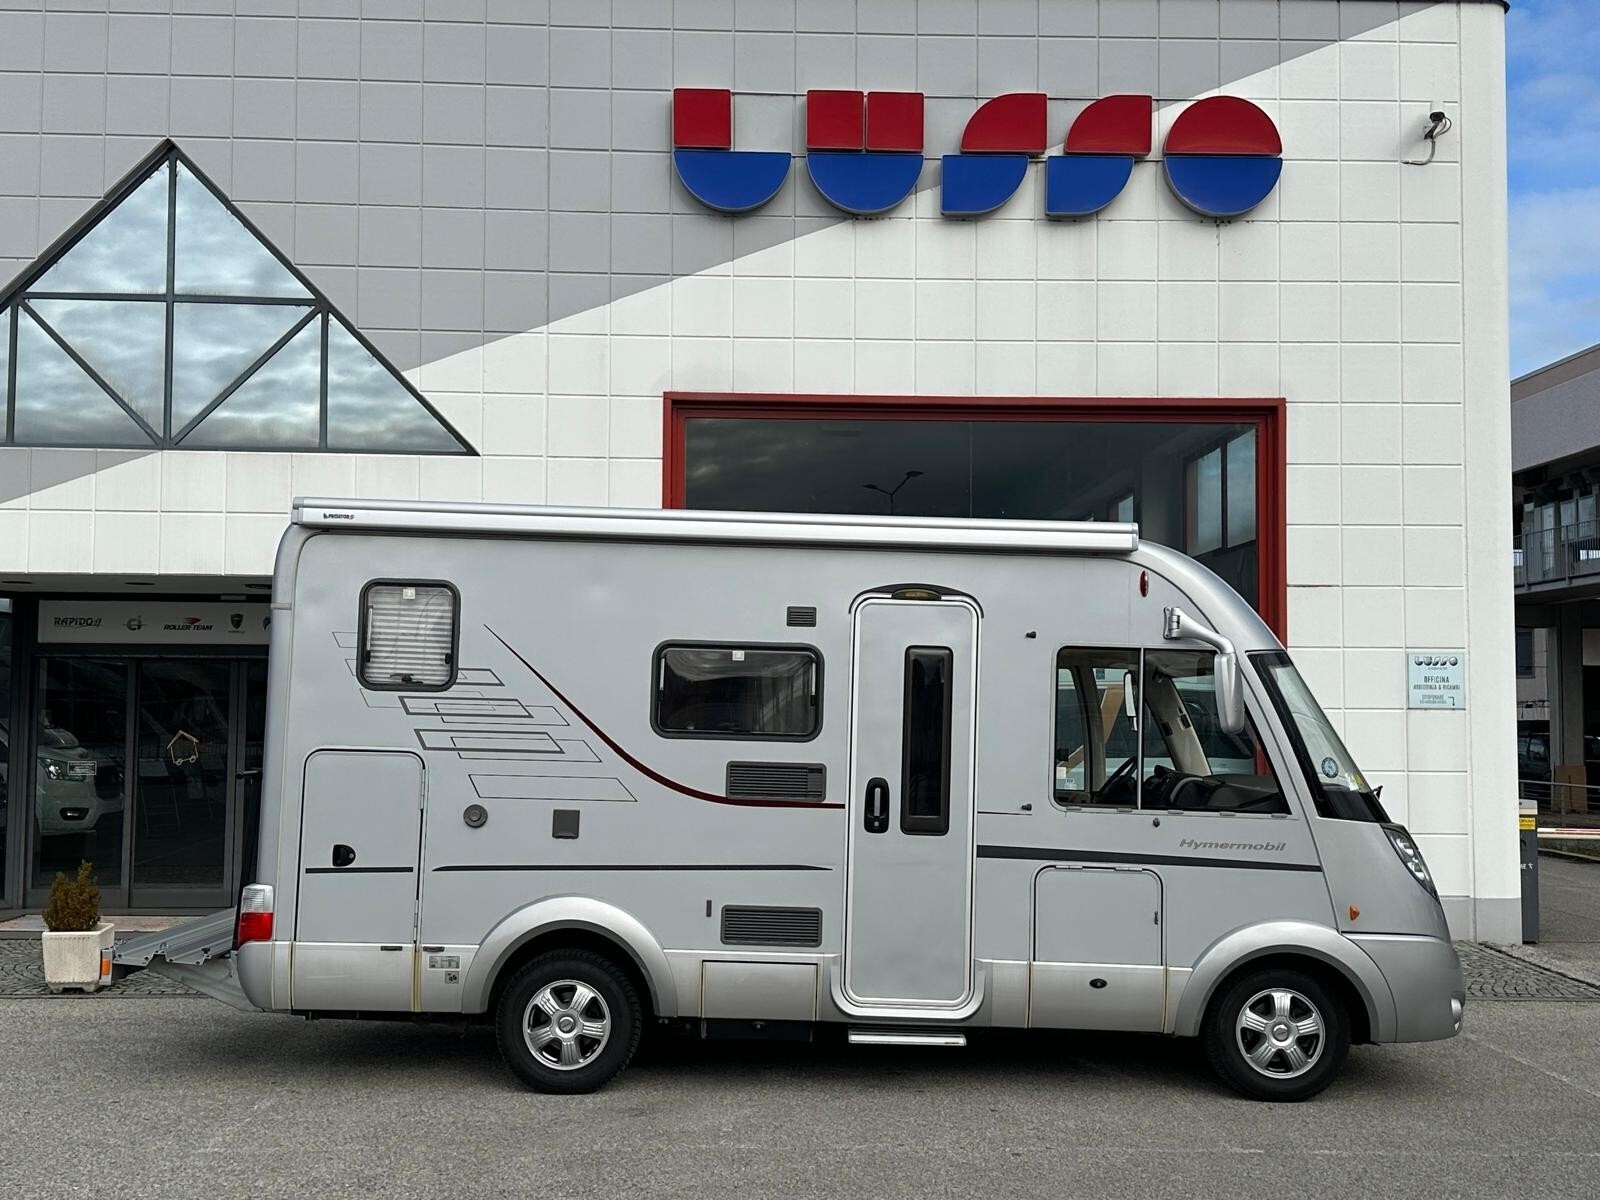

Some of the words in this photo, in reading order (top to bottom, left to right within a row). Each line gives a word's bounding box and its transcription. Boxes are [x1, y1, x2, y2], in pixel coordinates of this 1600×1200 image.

[673, 87, 1282, 217] LUSSO
[54, 617, 93, 626] RAPIDO
[1179, 838, 1287, 851] Hymermobil
